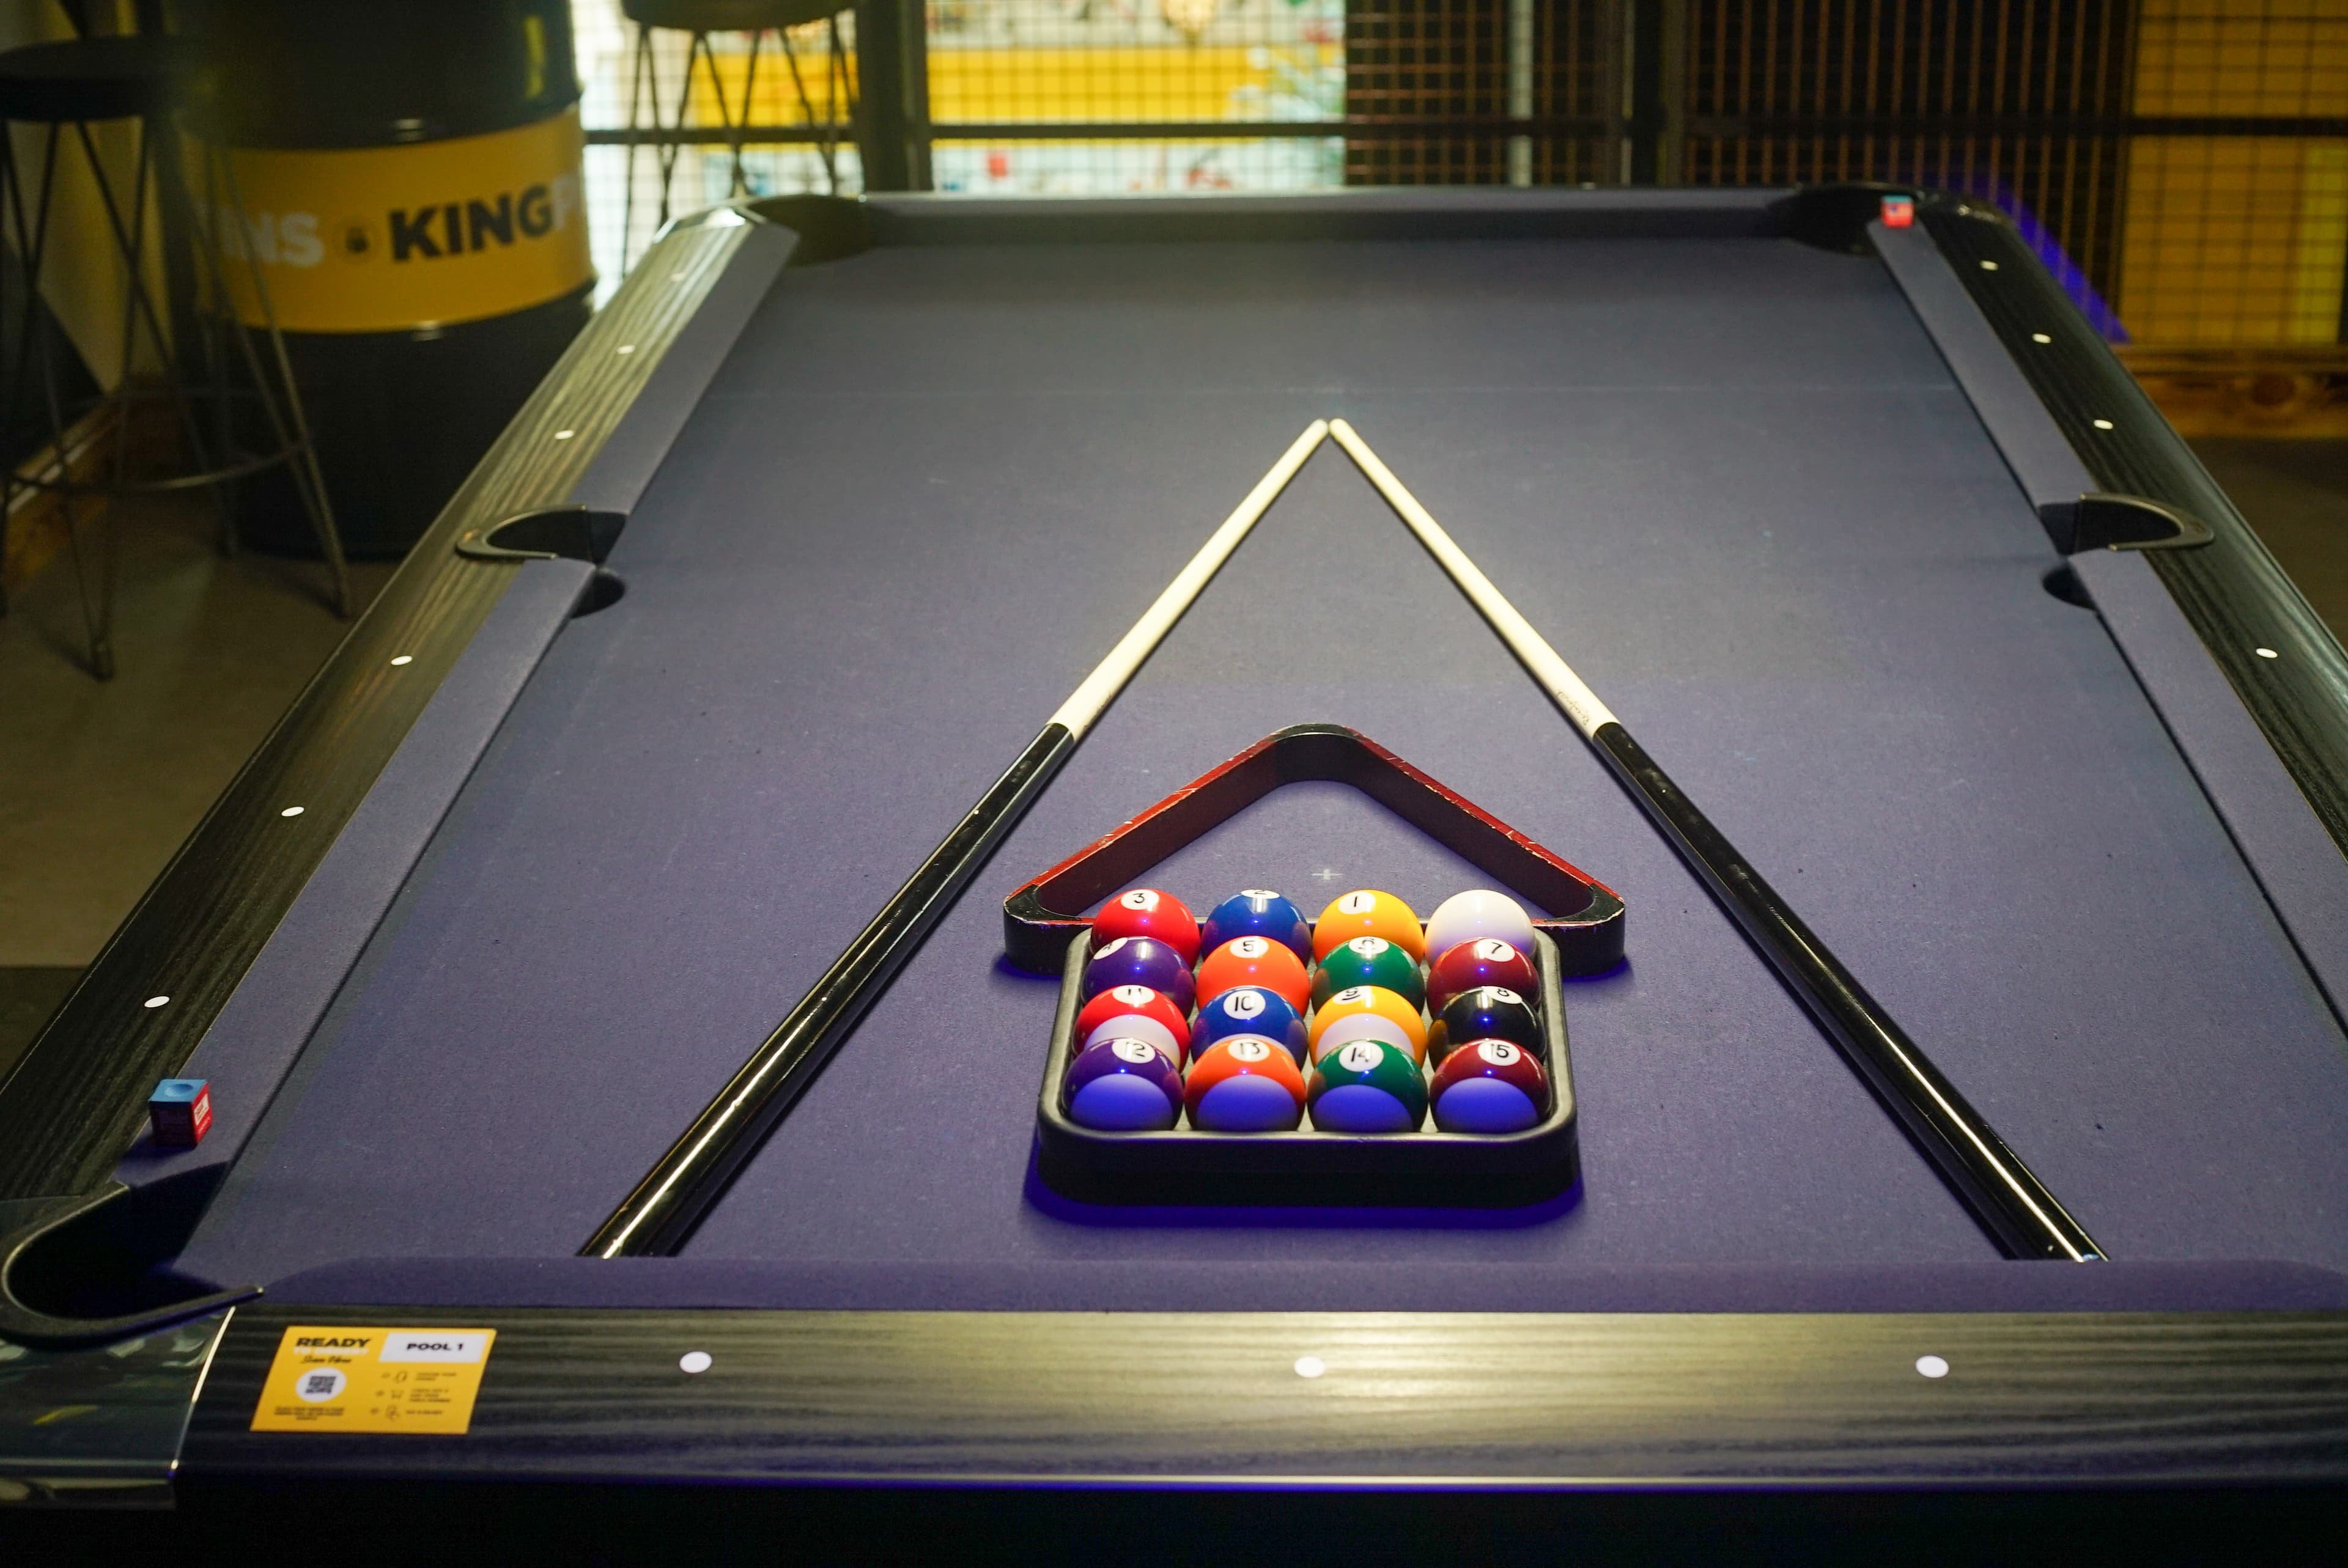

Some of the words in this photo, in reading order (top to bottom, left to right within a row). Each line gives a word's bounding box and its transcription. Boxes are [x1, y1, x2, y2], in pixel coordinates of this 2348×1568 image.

[1133, 893, 1145, 904] 3
[1353, 896, 1358, 908] 1
[1242, 940, 1255, 952] 5
[1492, 942, 1502, 954] 7
[1497, 988, 1510, 997] 8
[1240, 1042, 1260, 1055] 13
[1351, 1047, 1369, 1062] 14
[1491, 1044, 1510, 1058] 15
[296, 1337, 371, 1347] READY
[406, 1342, 451, 1351] POOL
